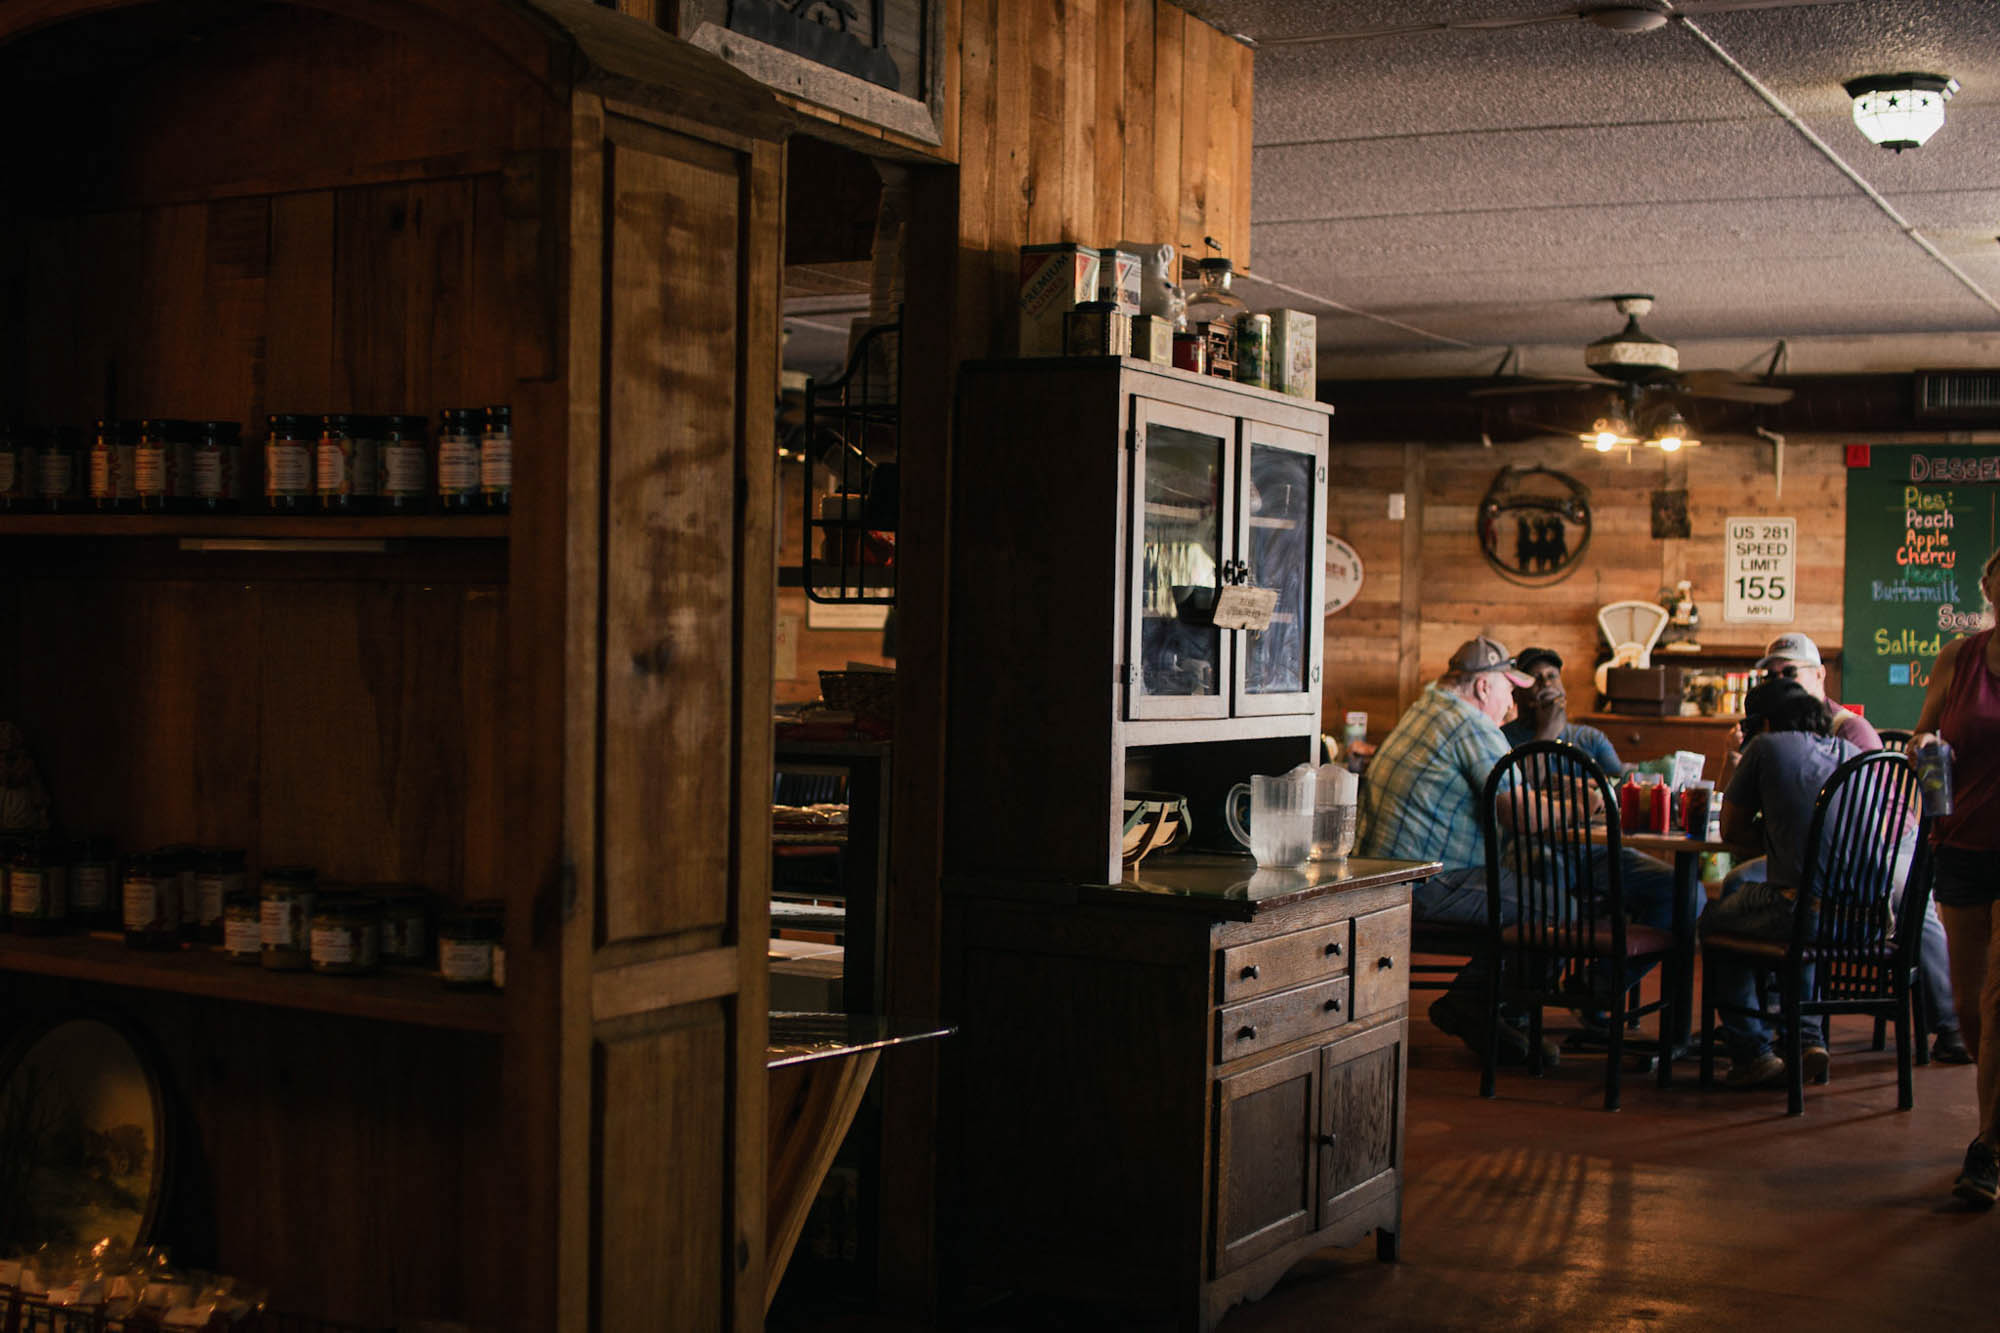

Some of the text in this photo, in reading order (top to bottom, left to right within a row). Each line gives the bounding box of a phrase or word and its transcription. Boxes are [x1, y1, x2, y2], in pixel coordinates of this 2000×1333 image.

[1906, 508, 1954, 529] Peach
[1733, 526, 1789, 540] US 281
[1906, 528, 1949, 552] Apple
[1736, 542, 1788, 556] SPEED
[1896, 546, 1956, 569] Cherry
[1741, 559, 1779, 572] LIMIT
[1735, 575, 1786, 601] 155
[1871, 579, 1960, 602] Buttermilk
[1746, 605, 1773, 616] MPH
[1874, 628, 1941, 656] Salted
